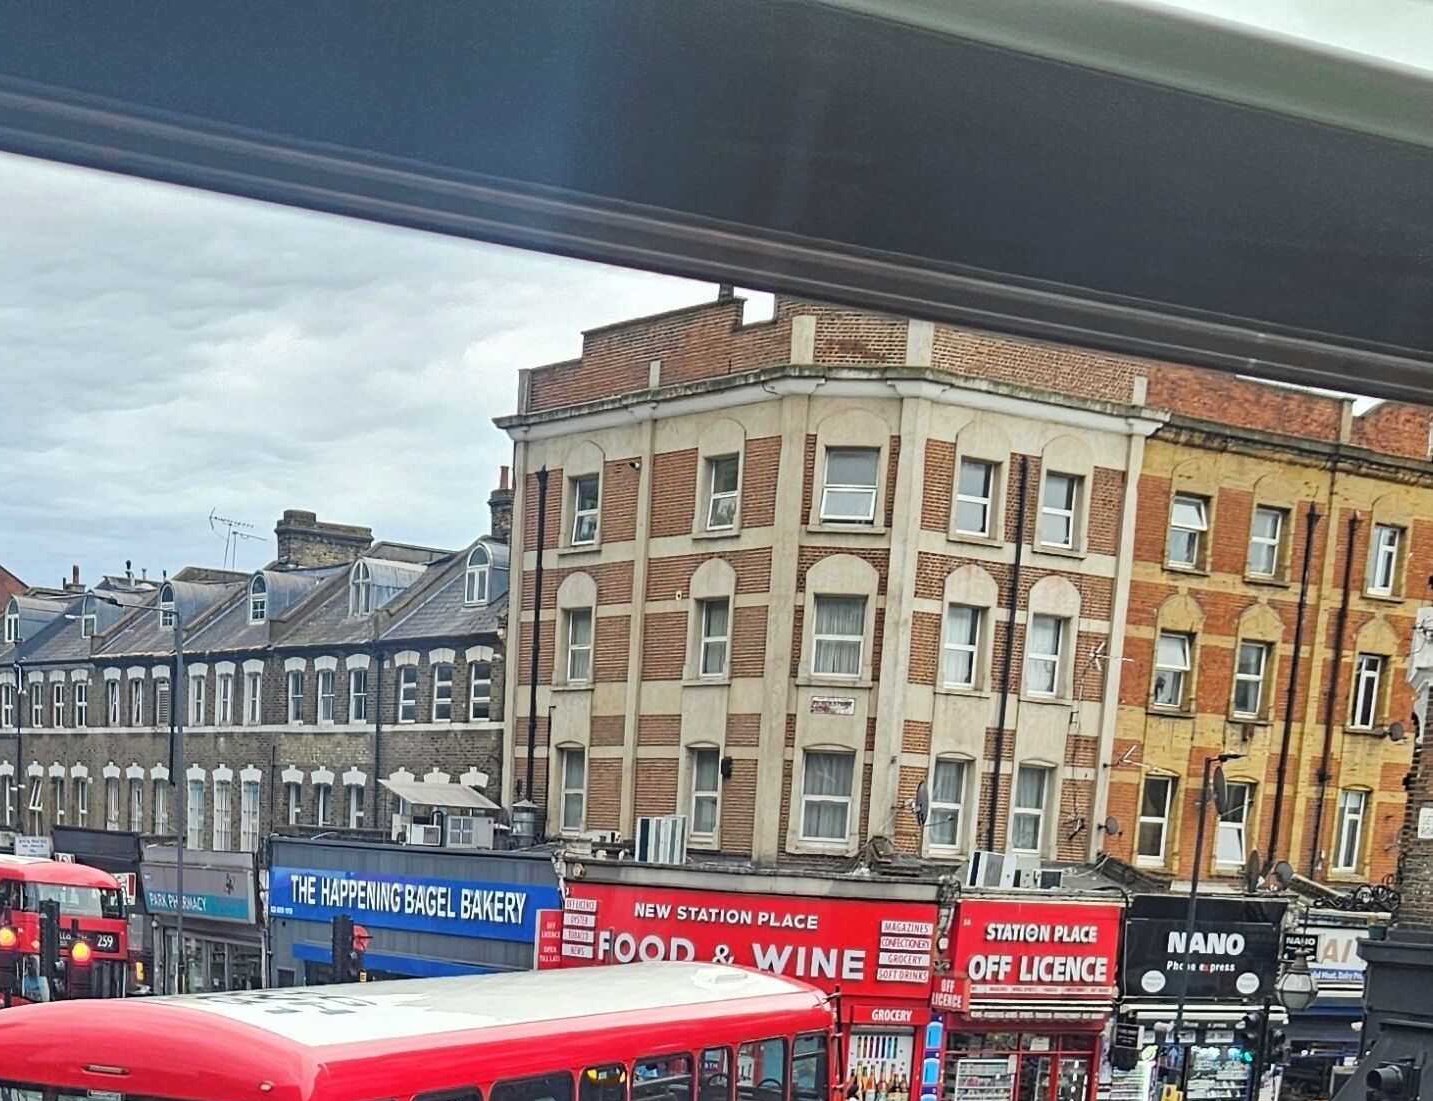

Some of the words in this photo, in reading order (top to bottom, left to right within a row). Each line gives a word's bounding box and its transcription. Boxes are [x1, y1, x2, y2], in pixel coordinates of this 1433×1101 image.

[149, 892, 168, 906] PARK
[168, 895, 207, 911] PHRMACY
[290, 875, 317, 904] THE
[321, 877, 401, 913] HAPPENING
[404, 884, 456, 918] BAGEL
[460, 888, 527, 924] BAKERY
[570, 914, 588, 925] OYSTER
[634, 902, 673, 918] NEW
[677, 906, 752, 924] STATION
[757, 912, 819, 929] PLACE
[884, 922, 929, 933] MAGAZINES
[986, 923, 1050, 942] STATION
[1053, 925, 1098, 943] PLACE
[97, 934, 114, 947] 259
[881, 938, 930, 949] CONFECTIONERY
[1167, 931, 1245, 955] NANO
[570, 946, 585, 956] NEWS
[598, 931, 696, 963] FOOD
[712, 944, 735, 964] &
[752, 943, 866, 980] WINE
[887, 954, 922, 965] GROCERY
[878, 969, 897, 979] SOFT
[898, 970, 928, 981] DRINKS
[968, 955, 1013, 981] OFF
[1019, 956, 1109, 982] LICENCE
[941, 979, 955, 992] OFF
[931, 992, 962, 1008] LICENCE
[871, 1009, 913, 1021] GROCERY
